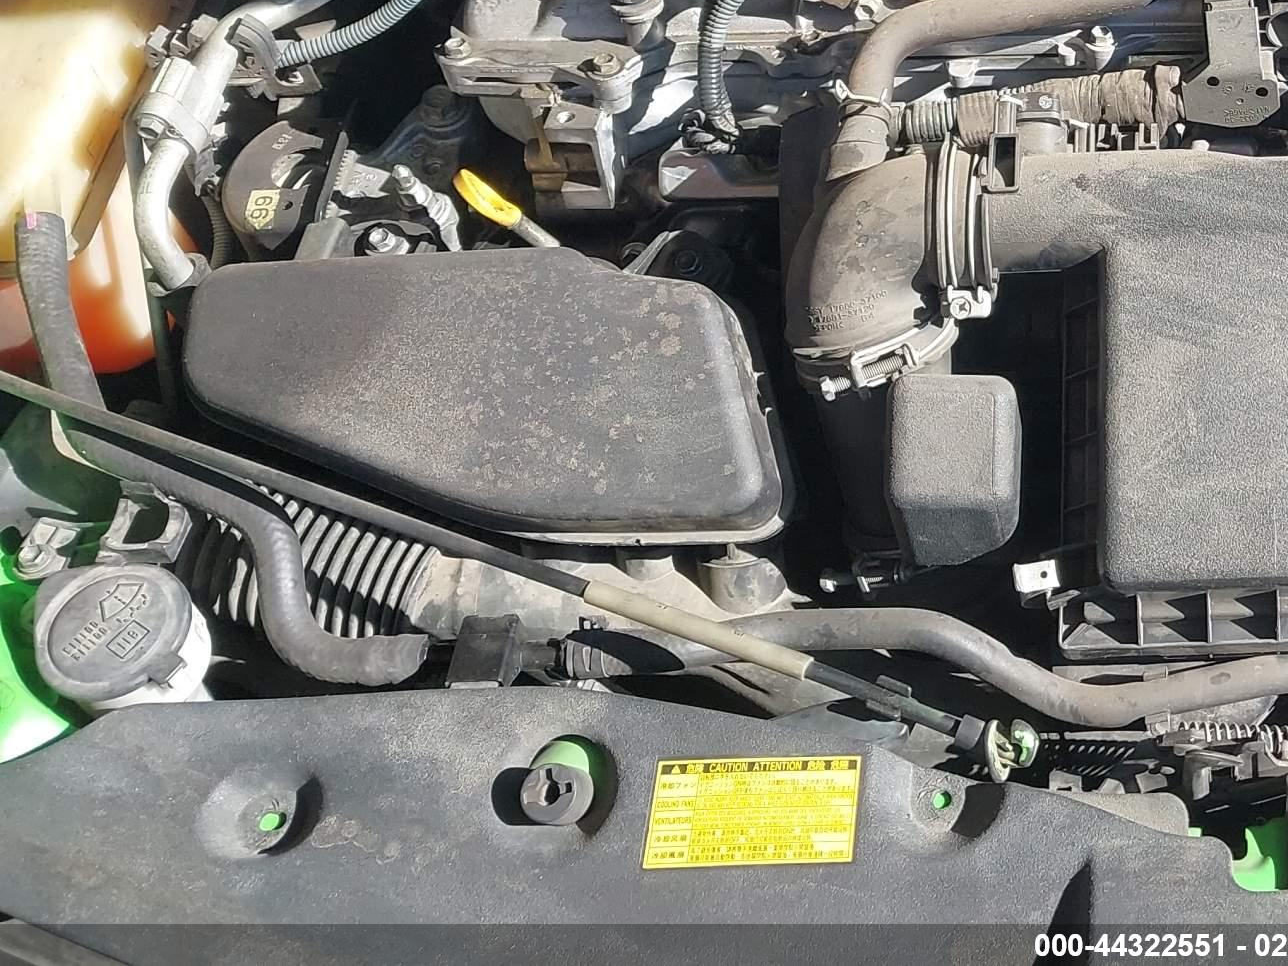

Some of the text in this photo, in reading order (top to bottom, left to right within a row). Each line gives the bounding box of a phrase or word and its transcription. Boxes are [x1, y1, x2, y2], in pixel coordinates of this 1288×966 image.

[709, 762, 748, 773] CAUTION
[753, 760, 802, 771] ATTENTION
[656, 801, 679, 809] COOLING
[654, 816, 692, 825] VENTILATEURS
